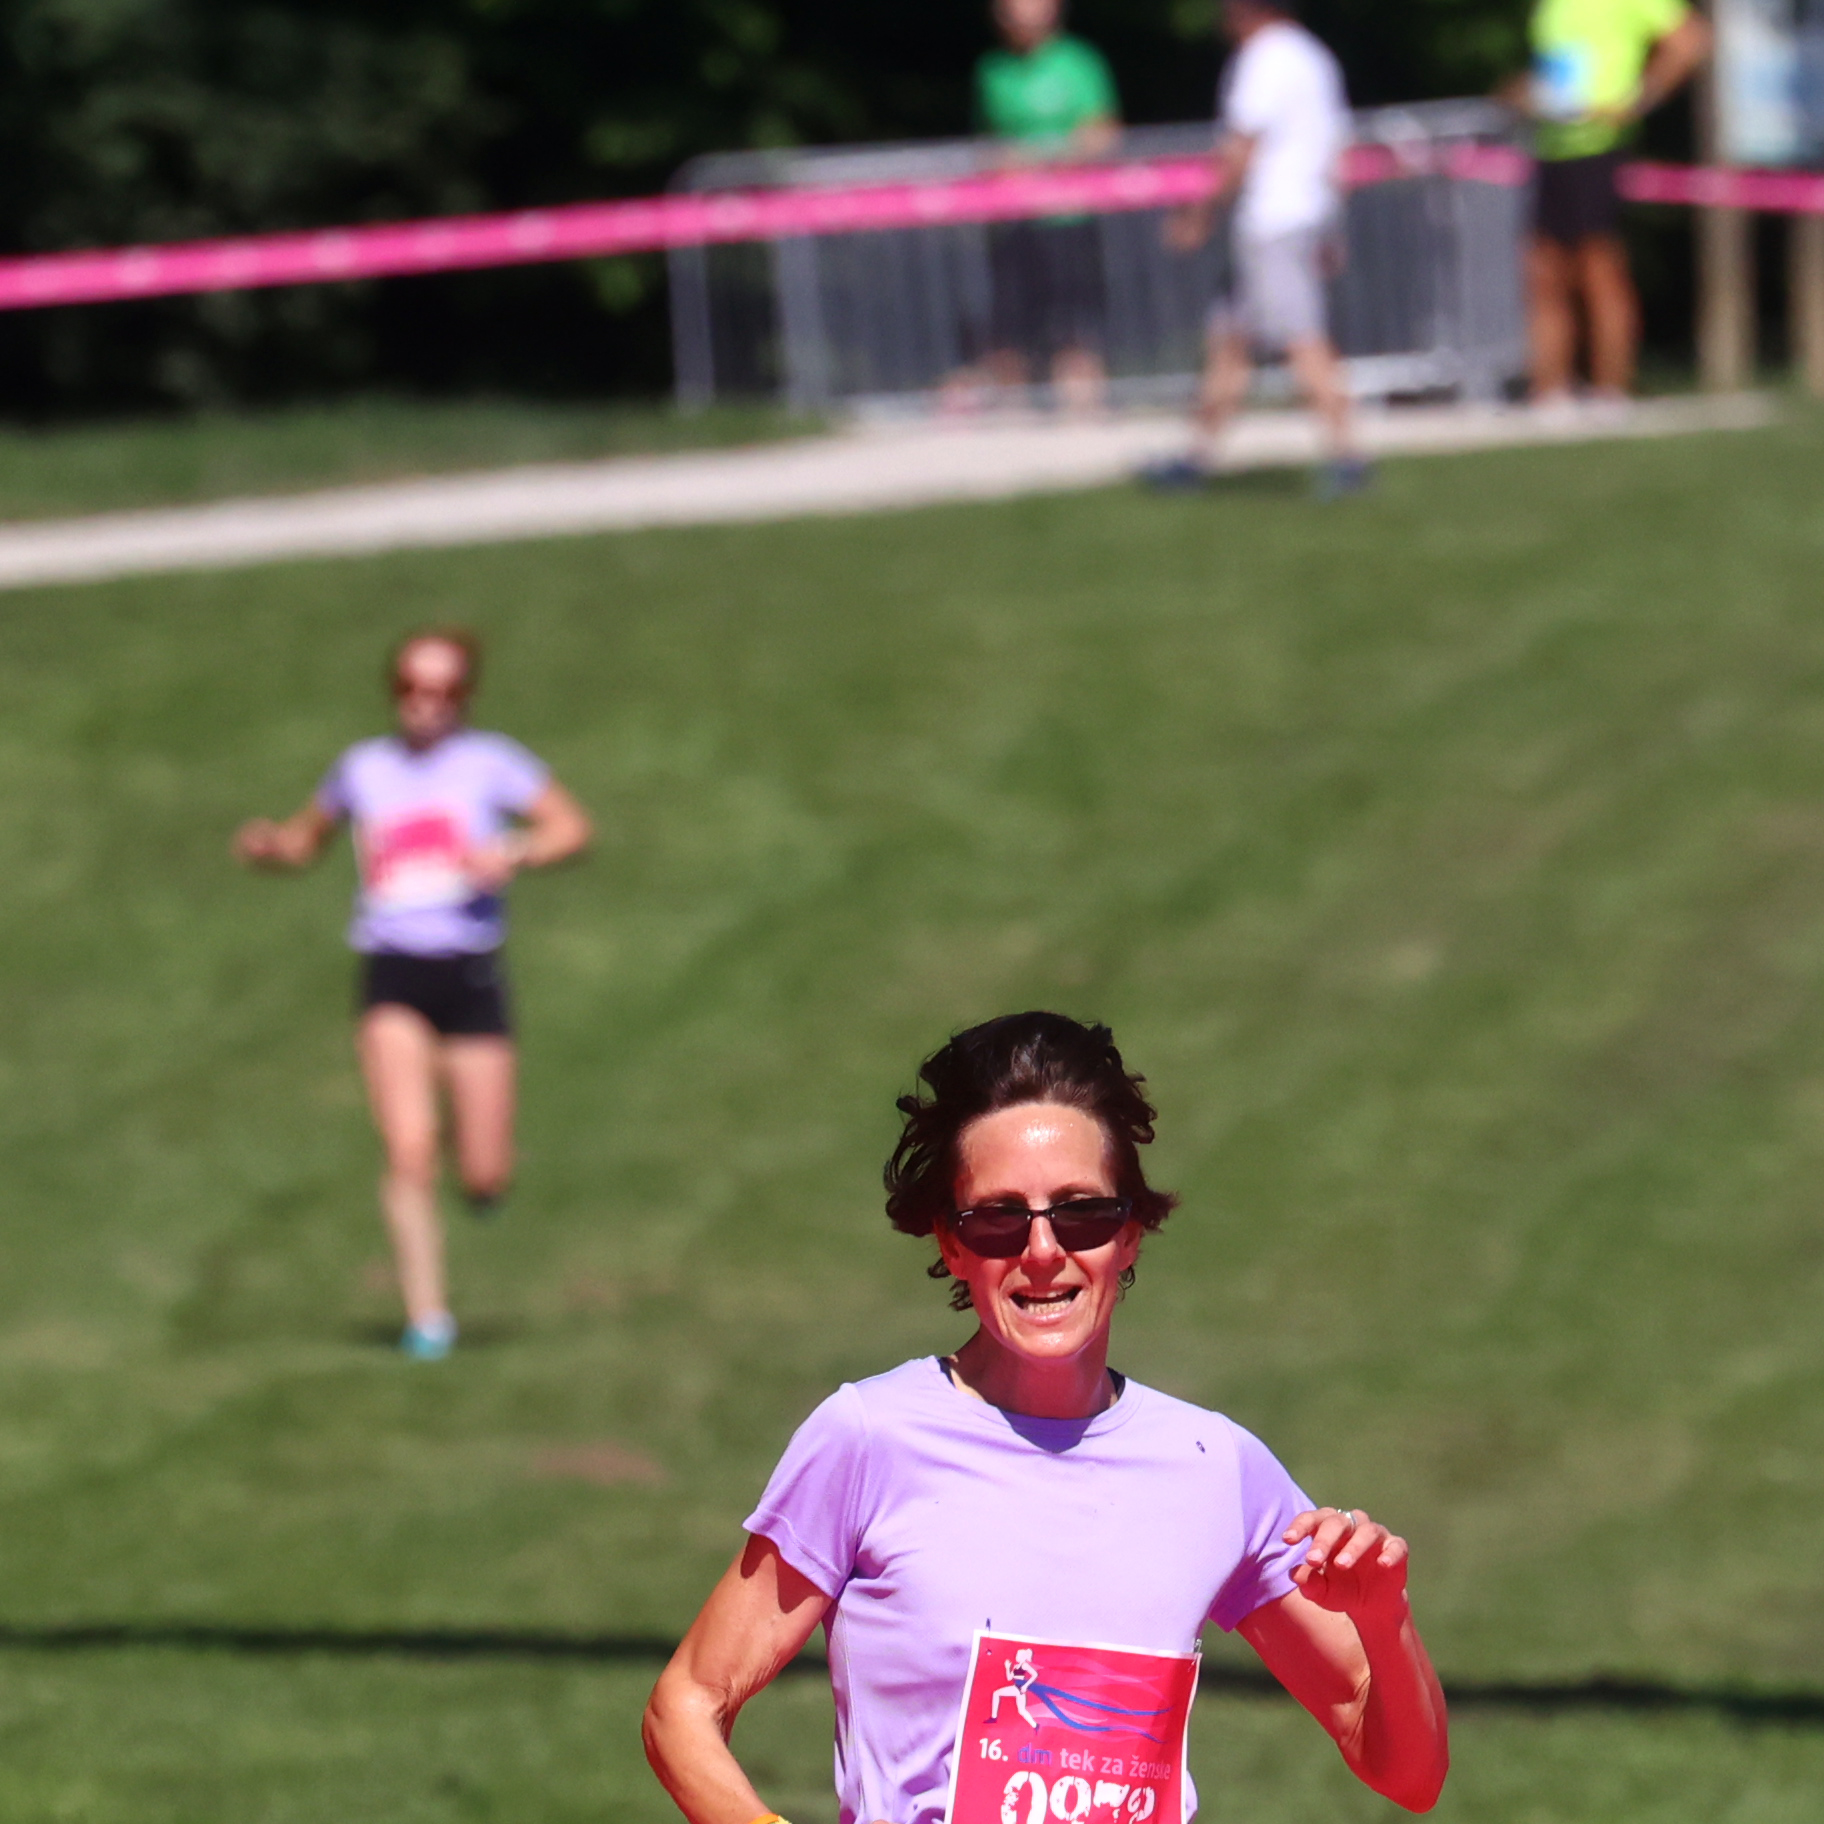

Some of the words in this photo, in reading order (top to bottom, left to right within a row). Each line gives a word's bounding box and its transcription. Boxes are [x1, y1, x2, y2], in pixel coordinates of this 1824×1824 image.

[978, 1738, 1008, 1762] 16.
[1018, 1742, 1052, 1764] dm
[1060, 1748, 1094, 1772] tek
[1100, 1757, 1122, 1775] za
[1129, 1755, 1171, 1780] ženske
